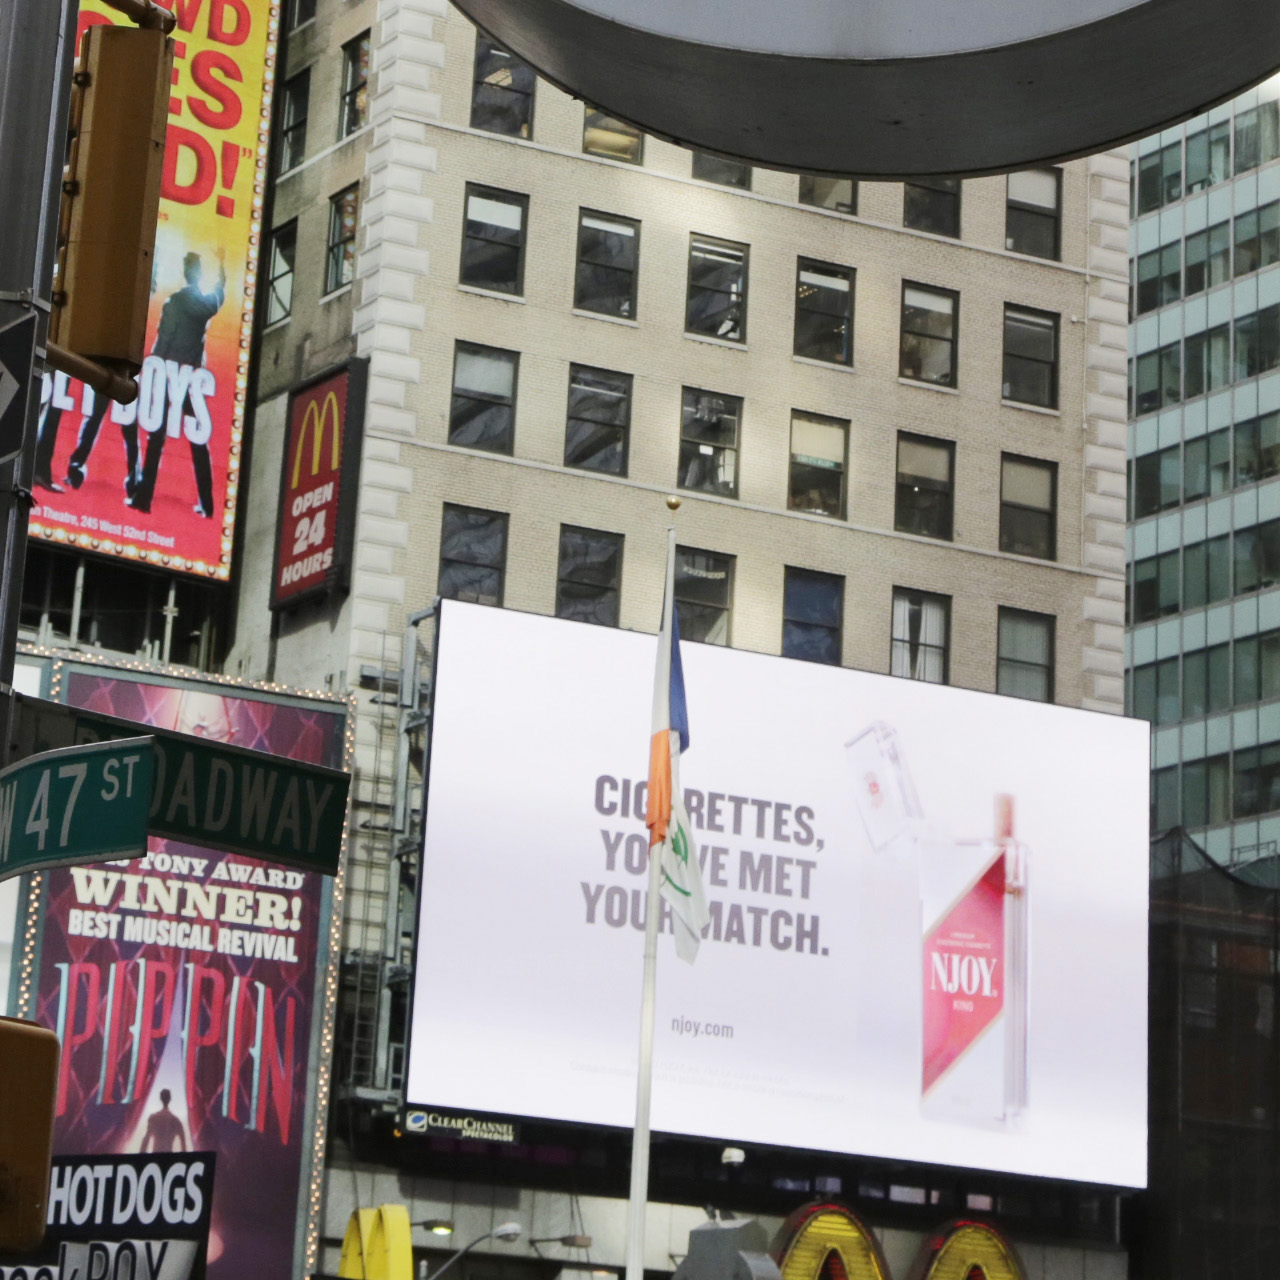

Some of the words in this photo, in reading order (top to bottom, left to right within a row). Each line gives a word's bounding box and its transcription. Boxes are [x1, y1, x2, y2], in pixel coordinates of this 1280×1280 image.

[291, 482, 334, 517] OPEN
[42, 506, 79, 526] Theatre,
[81, 516, 98, 530] 245
[99, 518, 123, 535] West
[123, 524, 146, 541] 52nd
[147, 531, 176, 548] Street
[292, 510, 326, 555] 24
[280, 547, 333, 587] HOURS
[25, 762, 87, 851] 47
[100, 755, 140, 801] ST
[594, 774, 824, 852] CIGRETTES,
[138, 851, 208, 877] TONY
[738, 850, 817, 900] MET
[70, 867, 303, 932] WINNER!
[68, 908, 122, 940] BEST
[123, 916, 214, 952] MUSICAL
[218, 928, 299, 963] REVIVAL
[54, 958, 296, 1145] PIPPIN
[671, 1016, 735, 1039] njoy.com
[47, 1164, 113, 1225] HOT
[113, 1161, 206, 1224] DOGS
